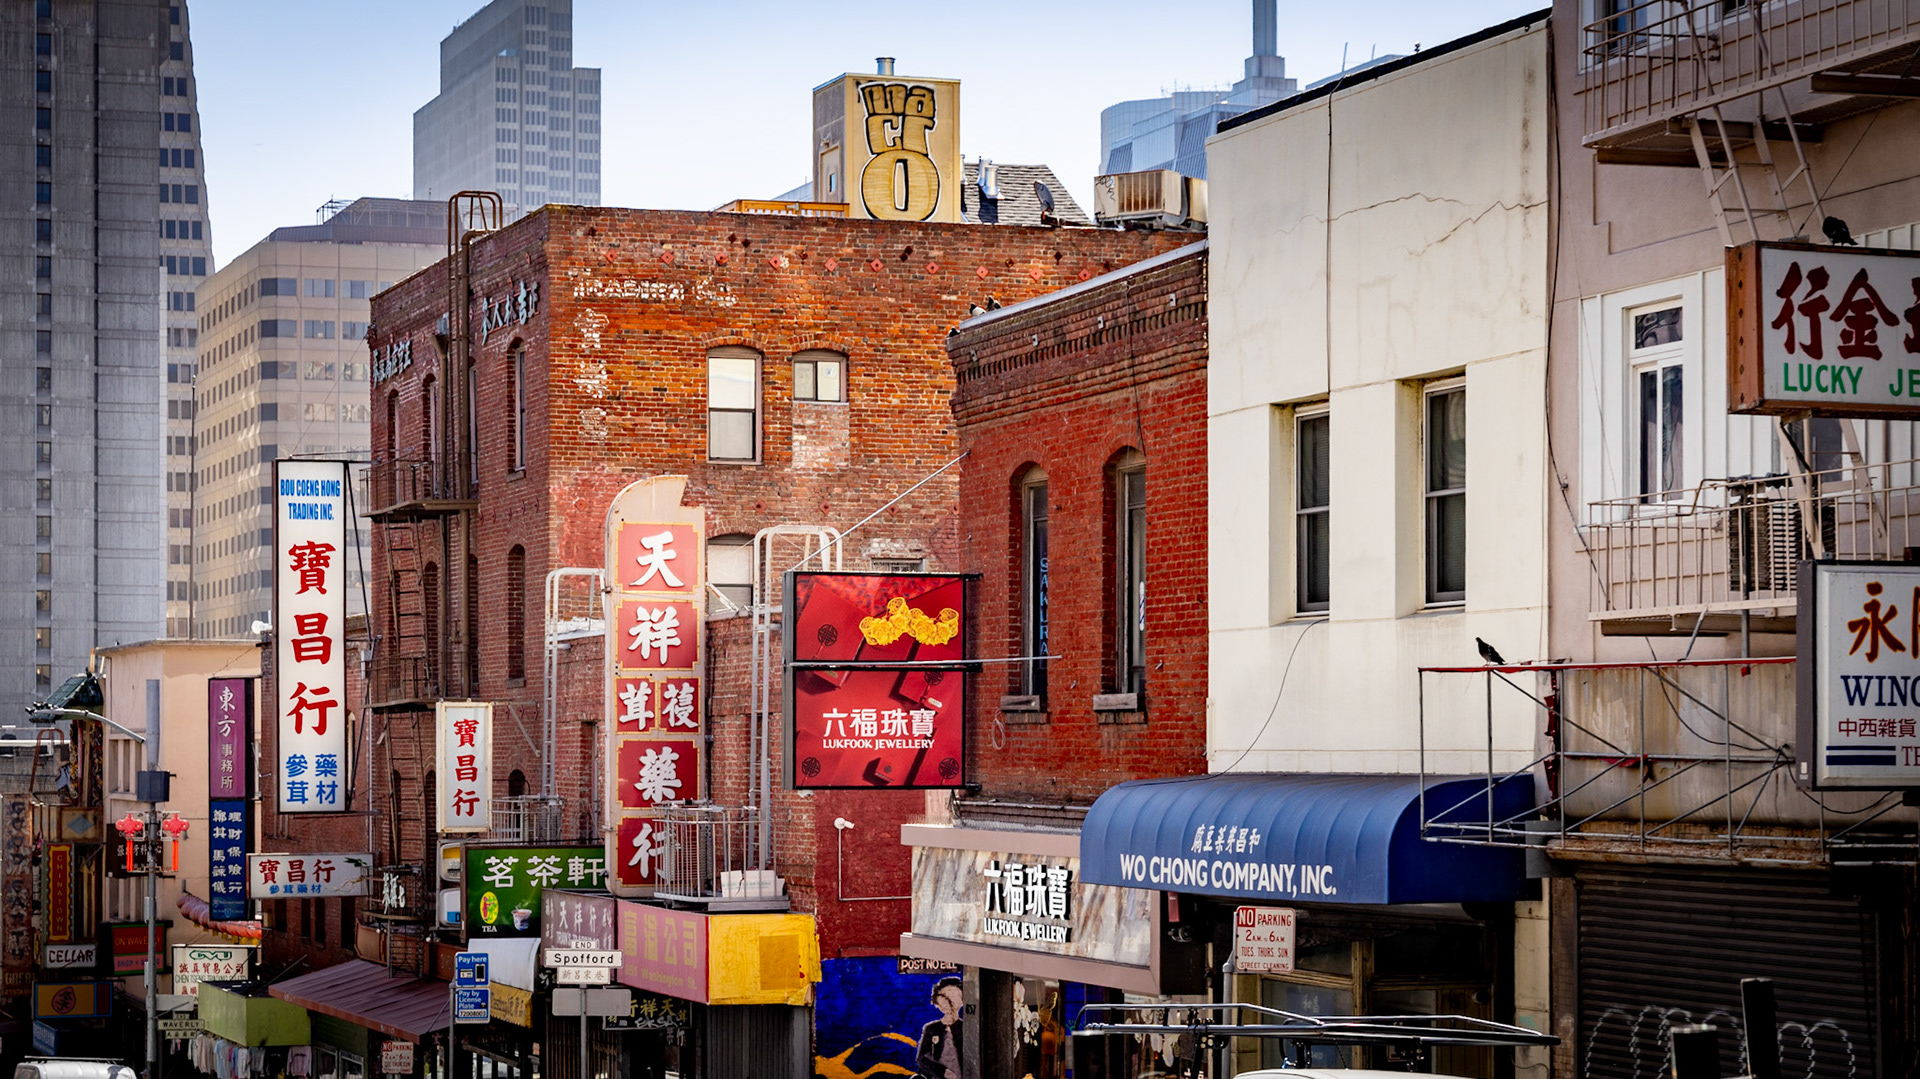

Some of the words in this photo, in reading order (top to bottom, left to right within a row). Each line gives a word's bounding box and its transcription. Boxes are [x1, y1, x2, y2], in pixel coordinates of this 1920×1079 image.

[1783, 362, 1863, 395] LUCKY
[280, 479, 295, 496] BOU
[296, 479, 319, 497] COENG
[321, 480, 341, 497] HONG
[288, 503, 318, 520] TRADING
[320, 503, 335, 520] INC.
[286, 540, 338, 736] 寶昌行
[822, 707, 937, 738] 六福珠寶
[1838, 718, 1917, 738] 中西雜貨
[822, 738, 873, 749] LUKFOOK
[874, 738, 936, 751] JEWELLERY
[451, 718, 481, 817] 寶昌行
[259, 858, 336, 885] 寶昌行
[482, 855, 606, 888] 茗茶軒
[1120, 853, 1147, 882] WO
[1149, 856, 1208, 887] CHONG
[1211, 860, 1297, 898] COMPANY,
[1300, 864, 1337, 896] INC.
[56, 854, 64, 932] CHINATOWN
[983, 860, 1069, 920] 六福珠寶
[1238, 909, 1254, 926] NO
[1257, 913, 1292, 927] PARKING
[482, 925, 497, 933] TEA
[983, 917, 1021, 938] LUKFOOK
[1021, 922, 1068, 944] JEWELLERY
[114, 937, 126, 946] ON
[127, 935, 162, 946] WAVEY
[575, 941, 592, 949] END
[48, 949, 94, 963] CELLAR
[458, 955, 471, 964] Pay
[471, 955, 487, 963] here
[554, 953, 614, 965] Spofford
[900, 959, 926, 970] POST
[926, 959, 939, 970] NO
[1262, 962, 1290, 970] CLEANING
[174, 974, 189, 983] CHEN
[641, 968, 683, 988] Washington
[471, 990, 480, 998] by
[382, 1042, 392, 1051] NO
